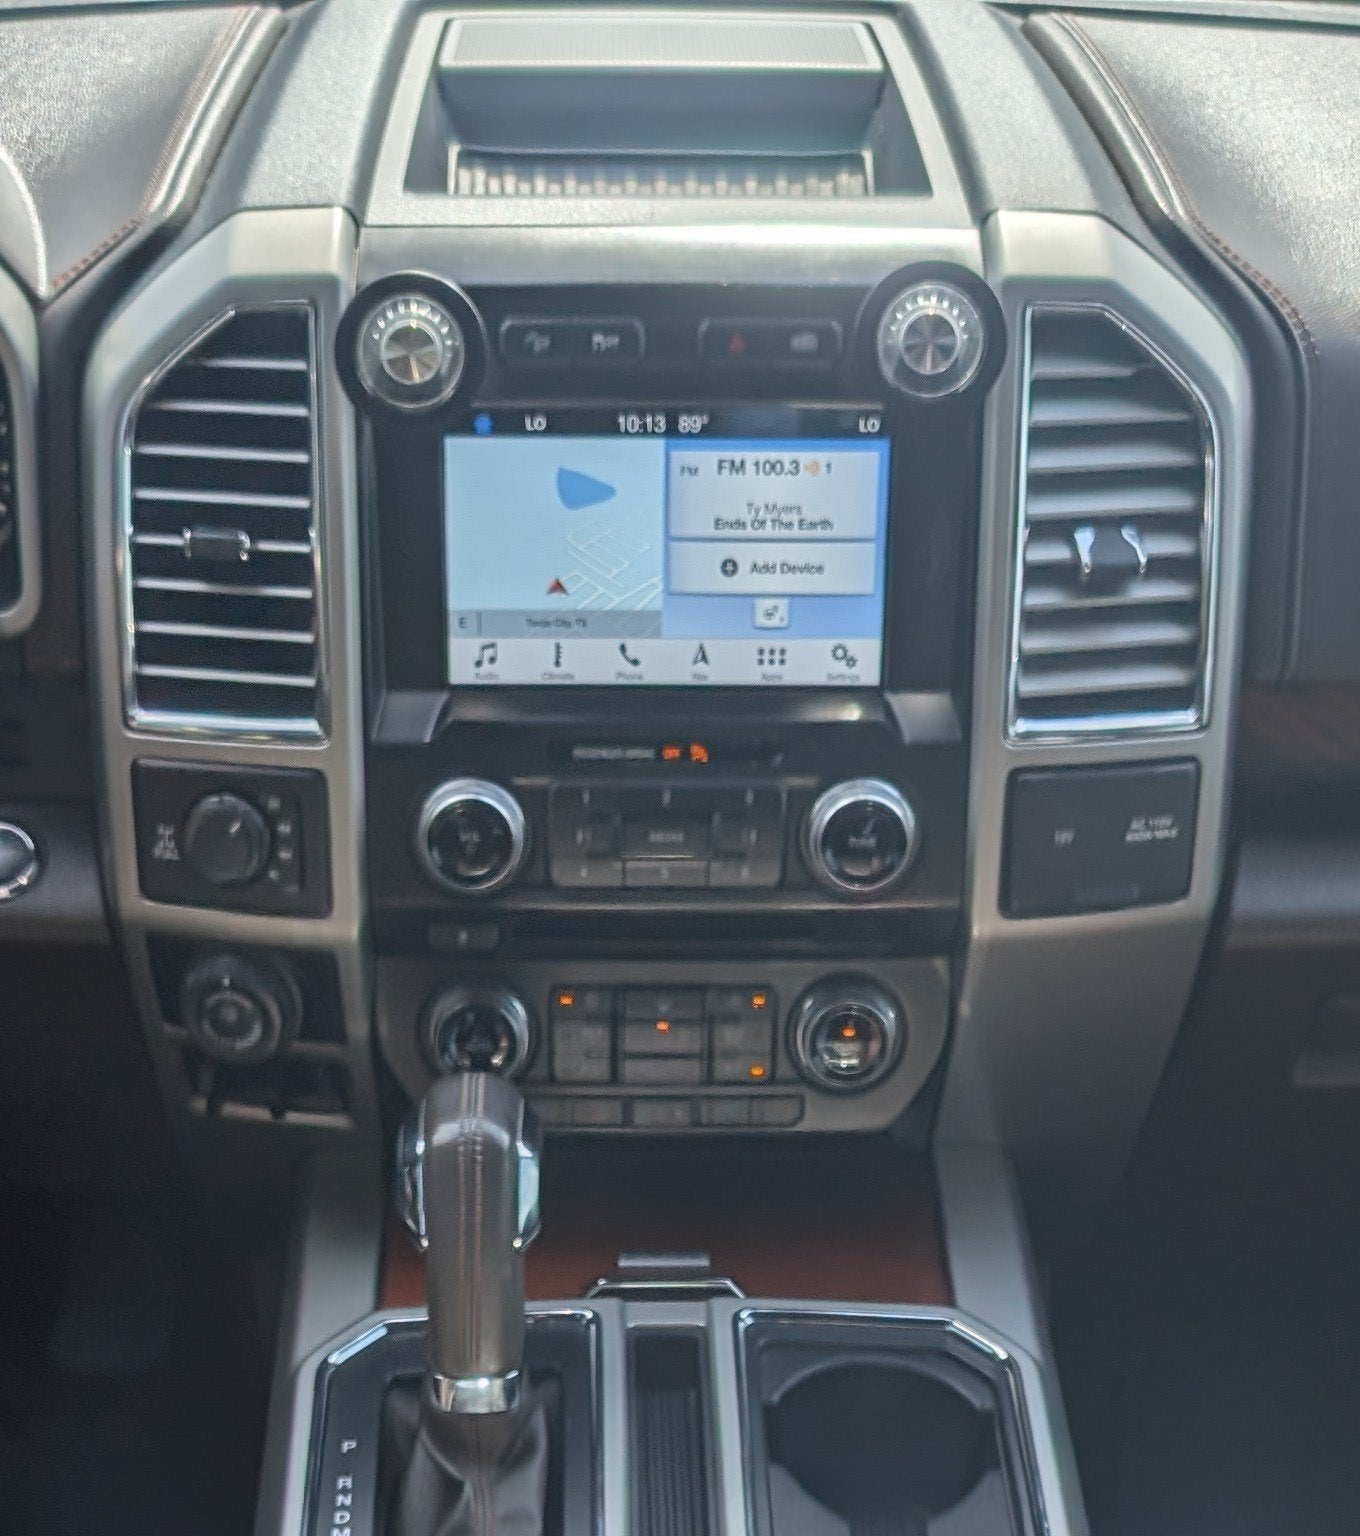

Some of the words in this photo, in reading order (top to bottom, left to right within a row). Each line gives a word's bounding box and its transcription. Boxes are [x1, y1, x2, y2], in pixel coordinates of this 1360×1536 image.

[524, 413, 548, 432] LO
[618, 413, 667, 434] 10:13
[858, 415, 881, 434] LO
[716, 459, 747, 476] FM
[753, 459, 801, 477] 100.3
[714, 518, 747, 531] Ends
[750, 518, 767, 531] Of
[771, 518, 794, 531] The
[798, 517, 834, 531] Earth
[750, 560, 777, 575] Add
[780, 560, 825, 576] Device
[342, 1439, 357, 1453] P
[333, 1510, 351, 1525] D
